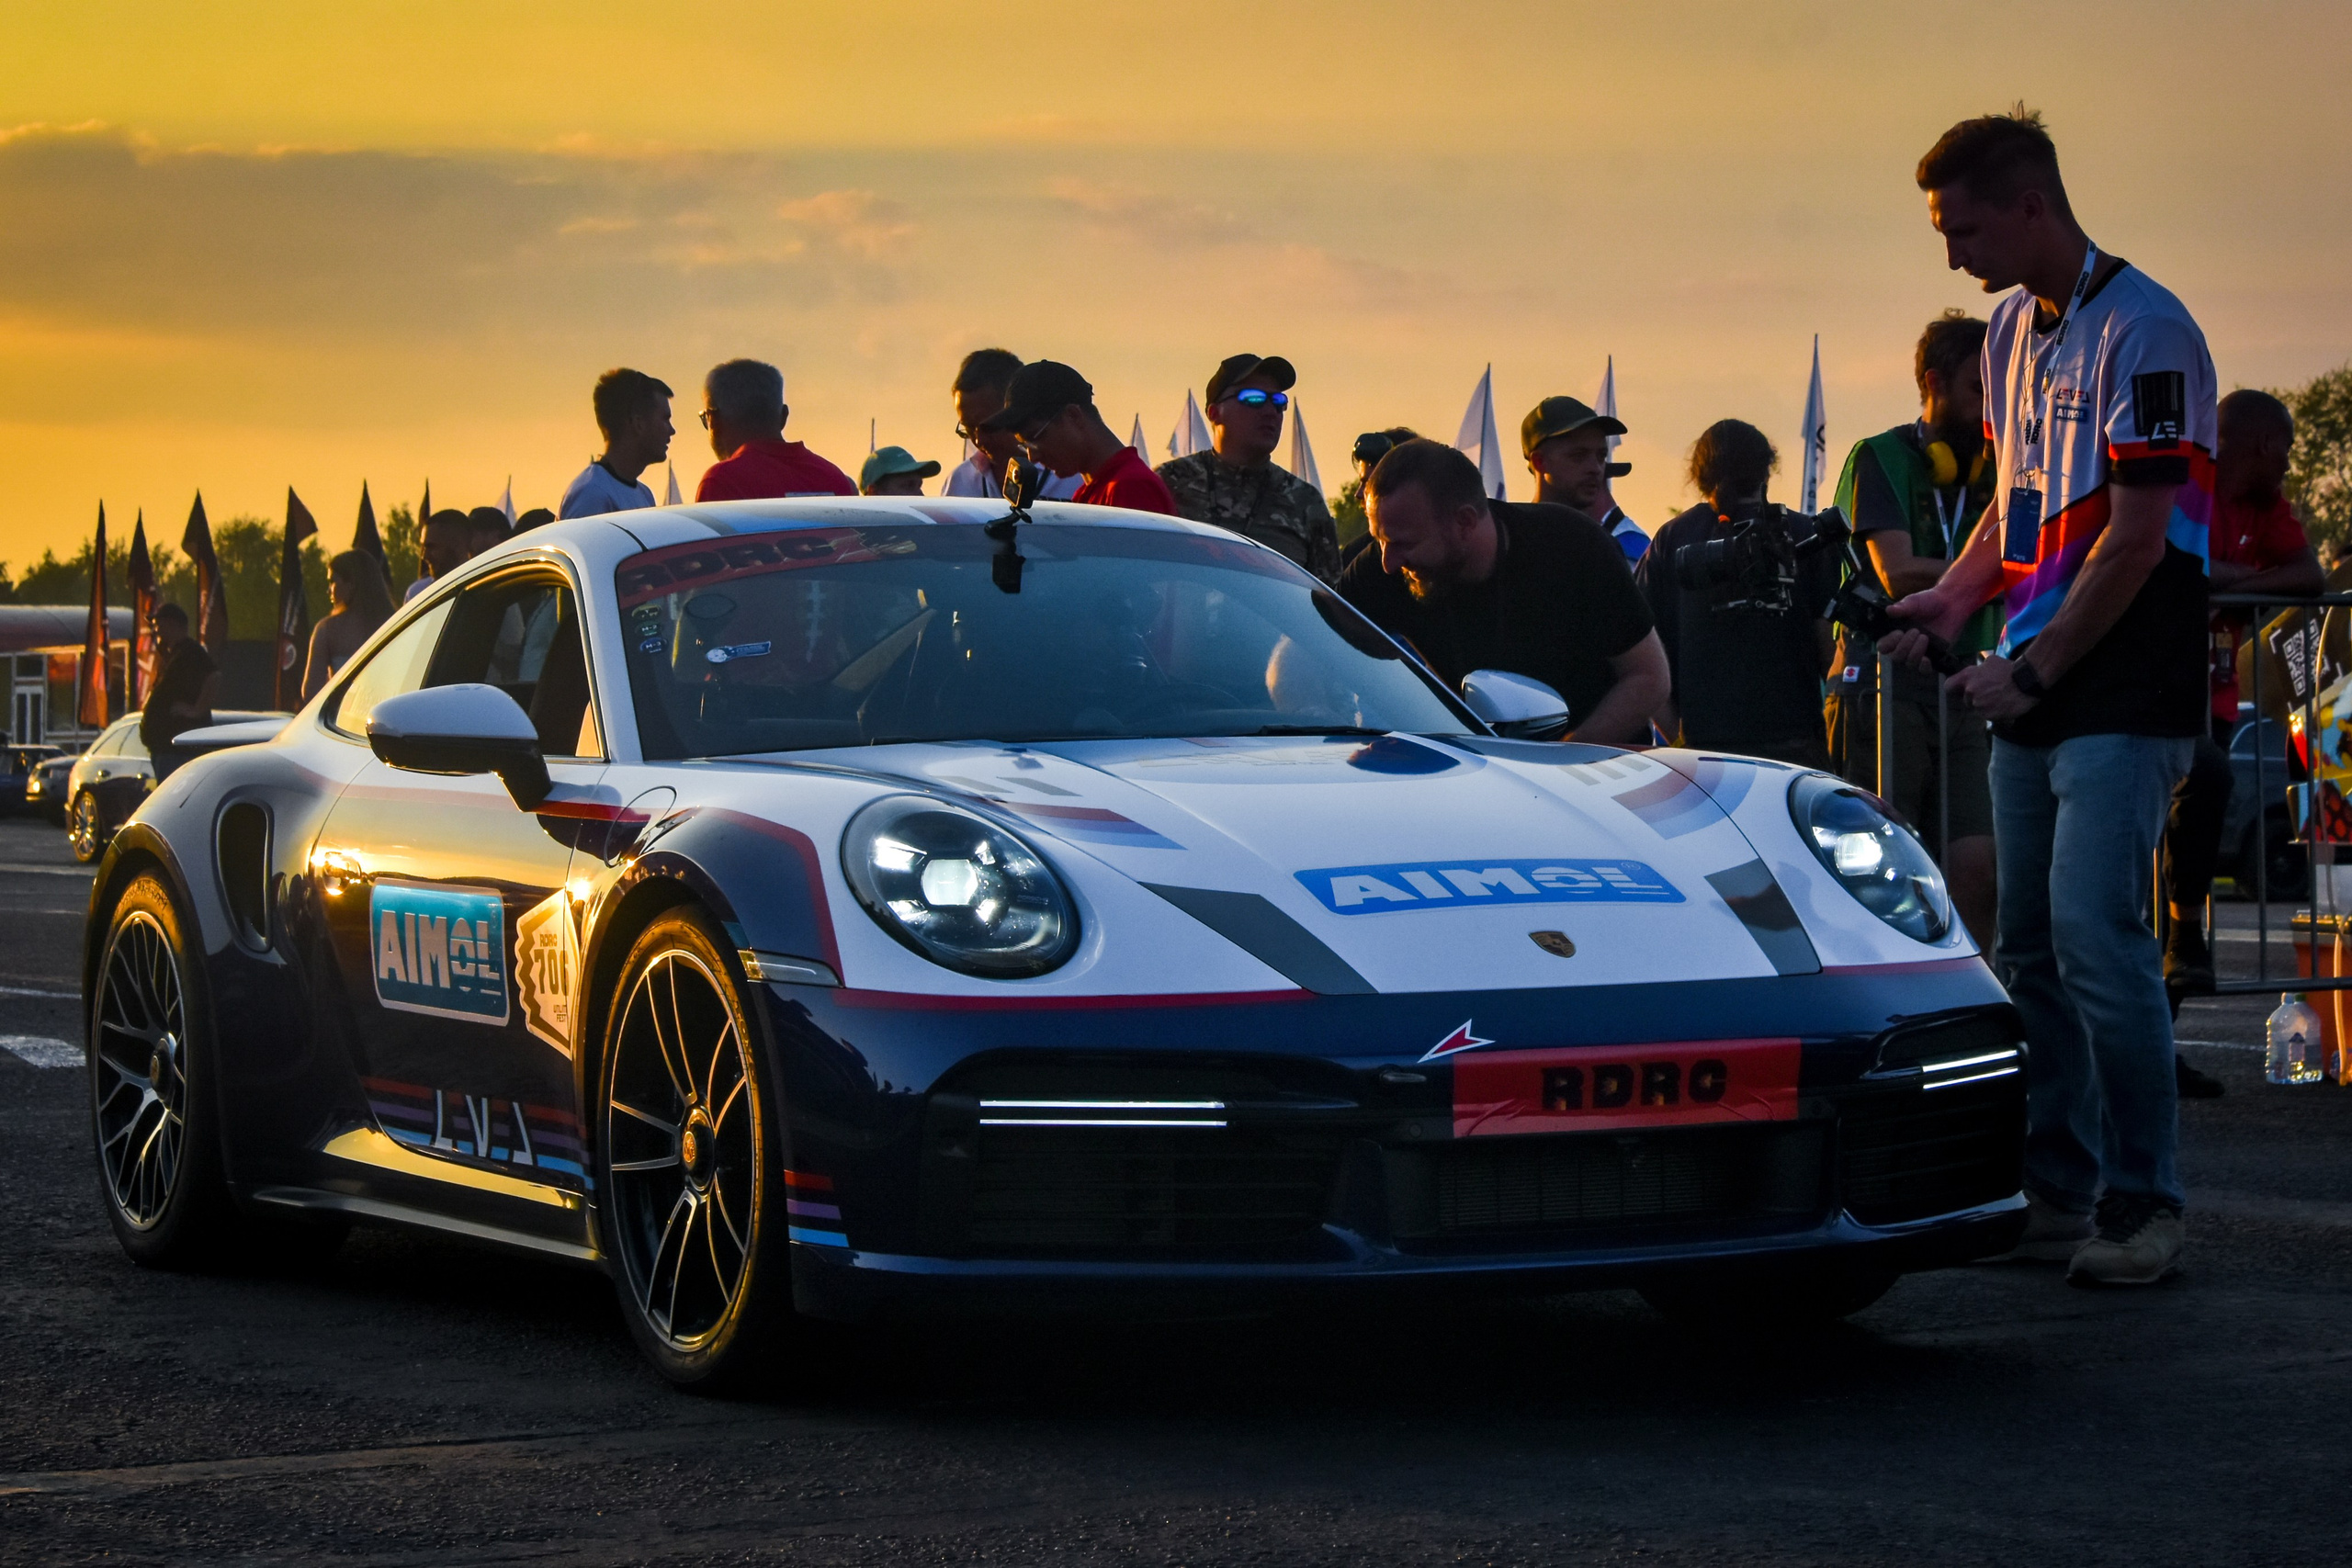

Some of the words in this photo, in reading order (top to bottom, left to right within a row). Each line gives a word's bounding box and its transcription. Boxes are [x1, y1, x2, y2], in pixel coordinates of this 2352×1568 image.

[1333, 866, 1670, 908] AIMOL
[379, 909, 503, 997] AIMOL
[538, 933, 558, 947] RDRC
[1541, 1058, 1728, 1111] RDRC
